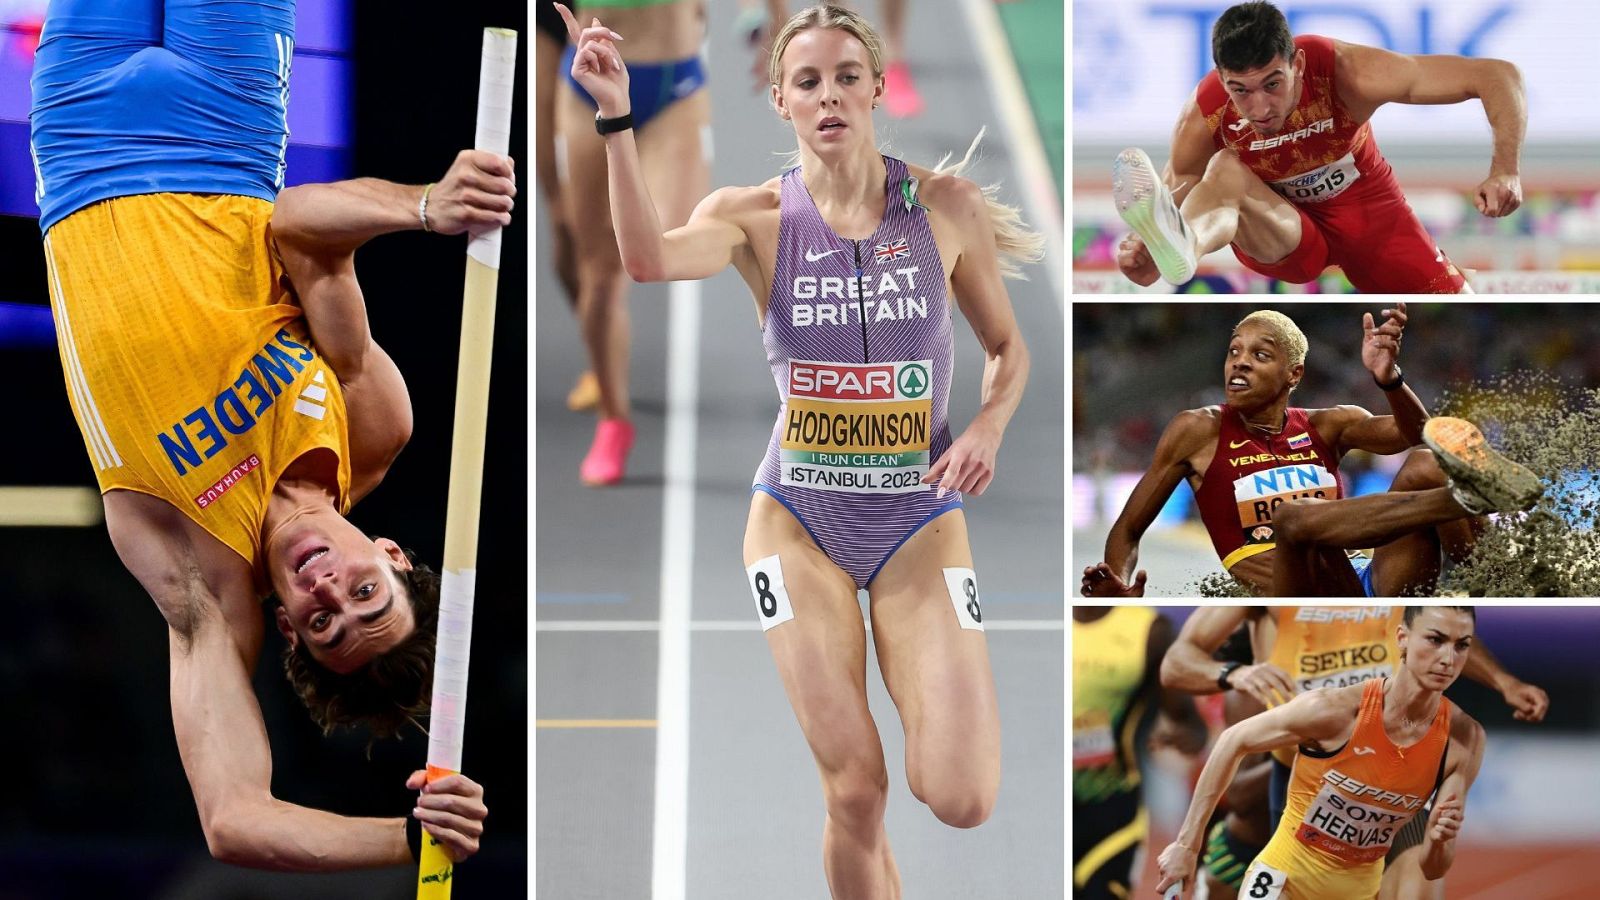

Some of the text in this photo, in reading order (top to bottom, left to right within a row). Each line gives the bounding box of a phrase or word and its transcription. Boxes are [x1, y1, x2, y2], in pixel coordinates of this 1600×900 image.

[1249, 117, 1334, 151] ESPAÑA
[793, 266, 919, 299] GREAT
[792, 296, 928, 327] BRITAIN
[792, 367, 891, 395] SPAR
[157, 328, 314, 477] SWEDEN
[786, 409, 926, 447] HODGKINSON
[812, 453, 816, 463] I
[819, 454, 849, 465] RUN
[197, 456, 260, 508] BAUHAUS
[790, 467, 920, 489] ISTANBUL 2023
[1253, 465, 1320, 495] NTN
[755, 571, 777, 618] 8
[963, 577, 982, 624] 8
[1301, 644, 1387, 674] SEIKO
[1327, 794, 1406, 824] SONY
[1310, 806, 1393, 846] HERVAS
[1249, 871, 1274, 898] 8
